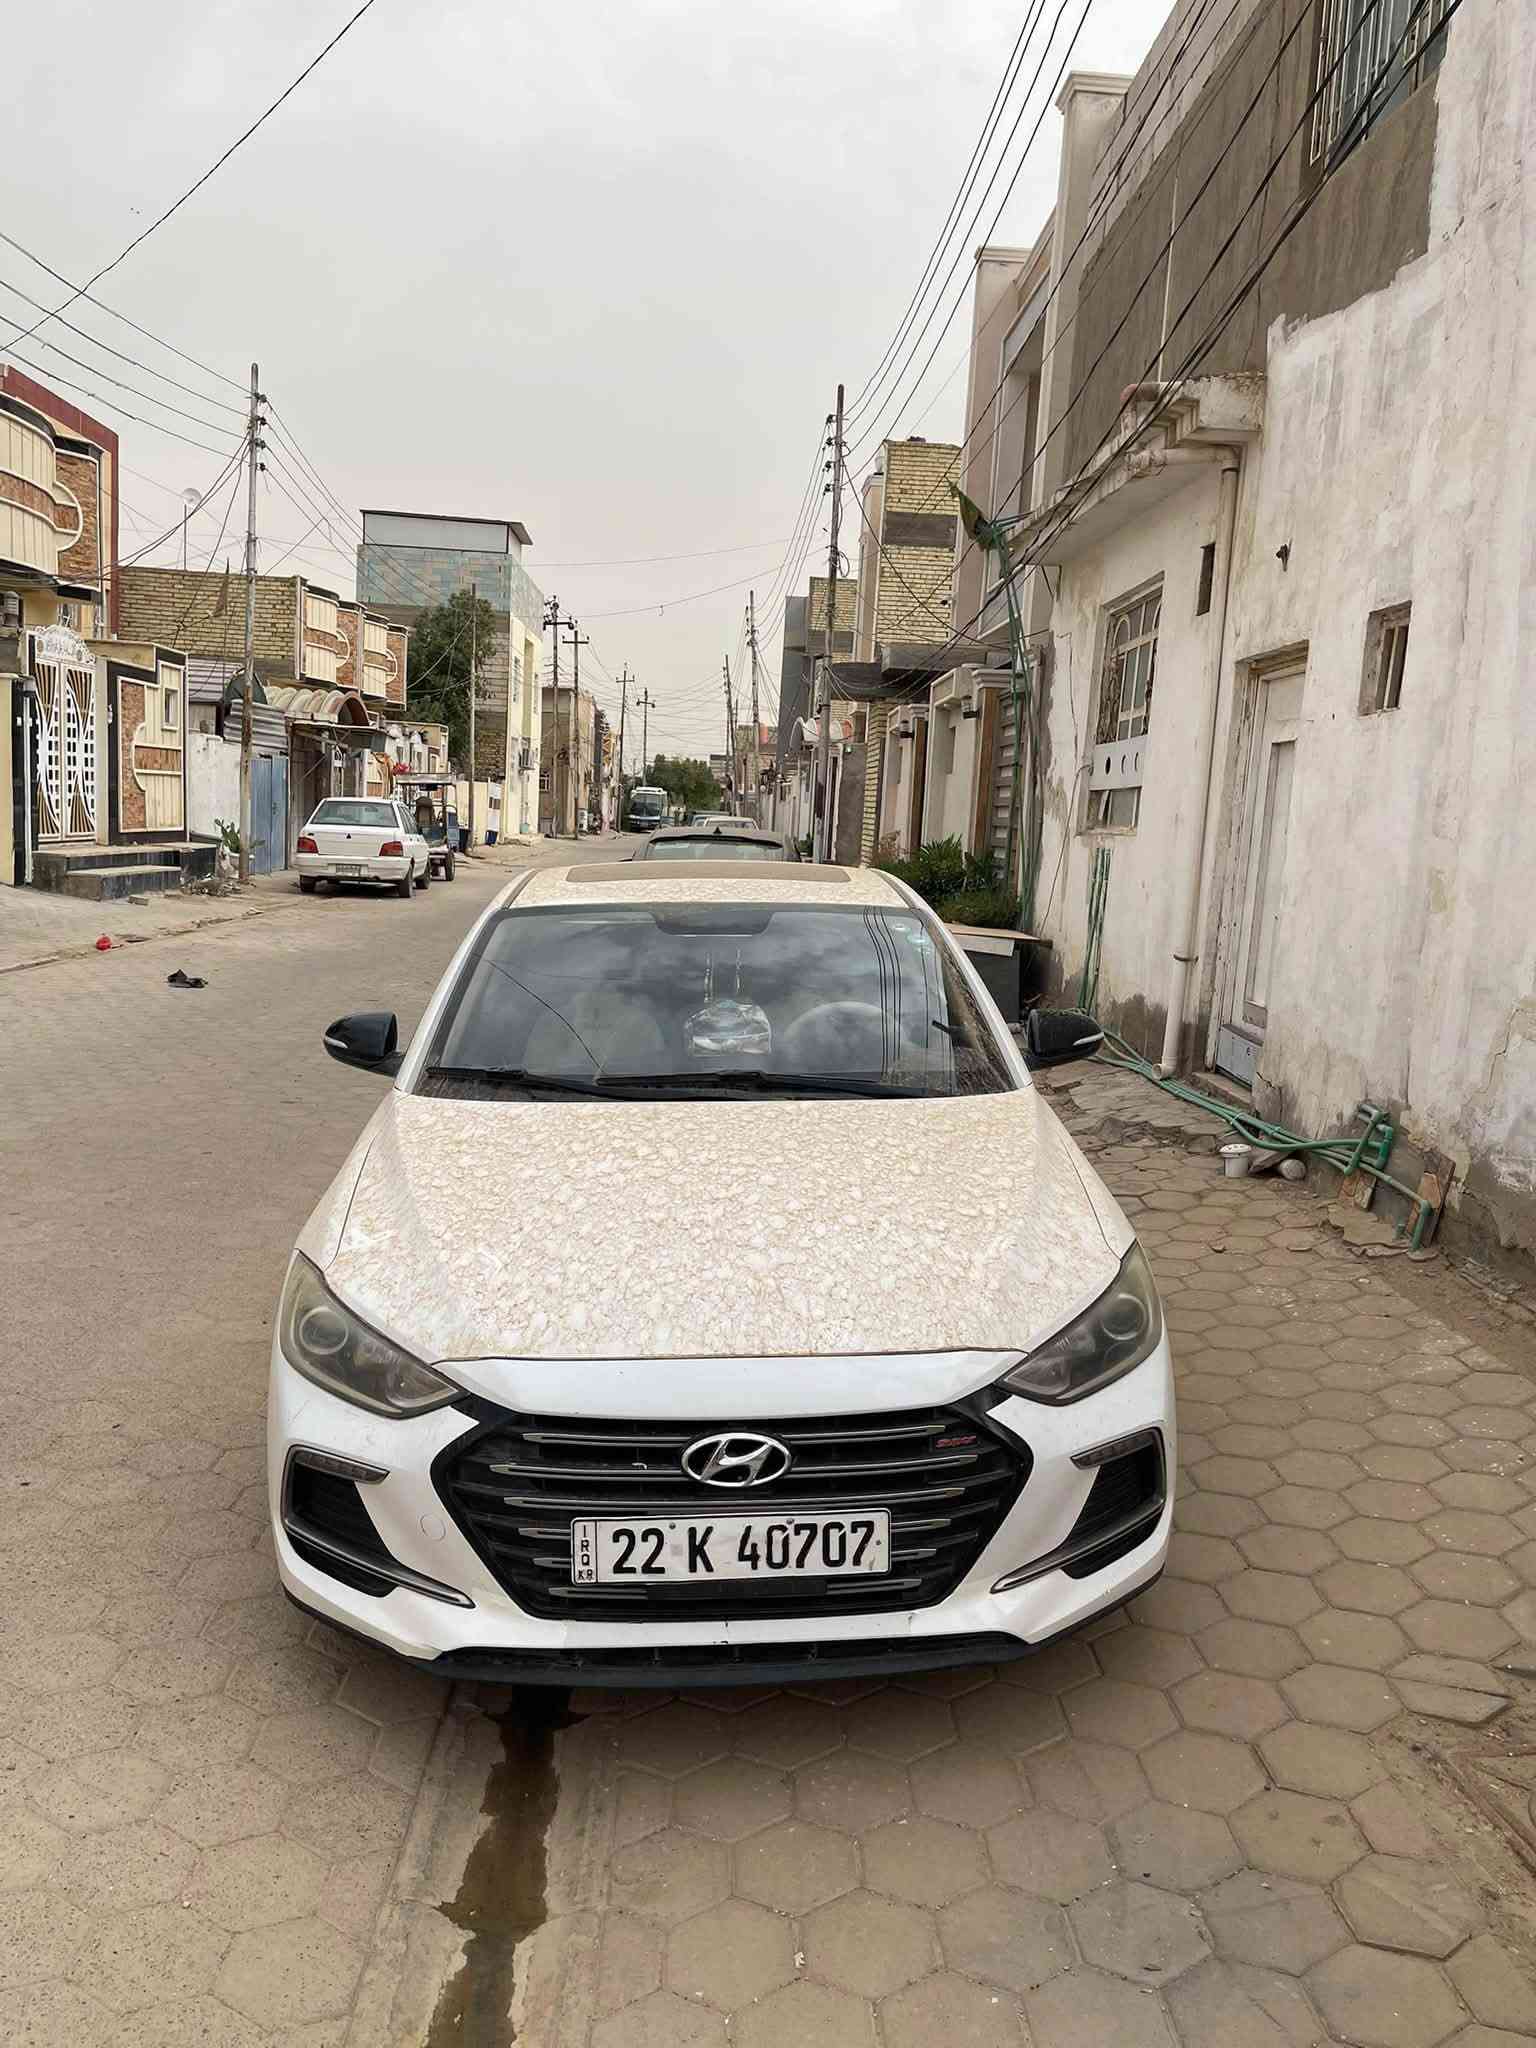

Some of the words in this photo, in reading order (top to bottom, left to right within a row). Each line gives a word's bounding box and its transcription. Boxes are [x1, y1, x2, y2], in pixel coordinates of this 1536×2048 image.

[612, 1527, 666, 1575] 22
[687, 1526, 714, 1574] K
[737, 1520, 876, 1571] 40707
